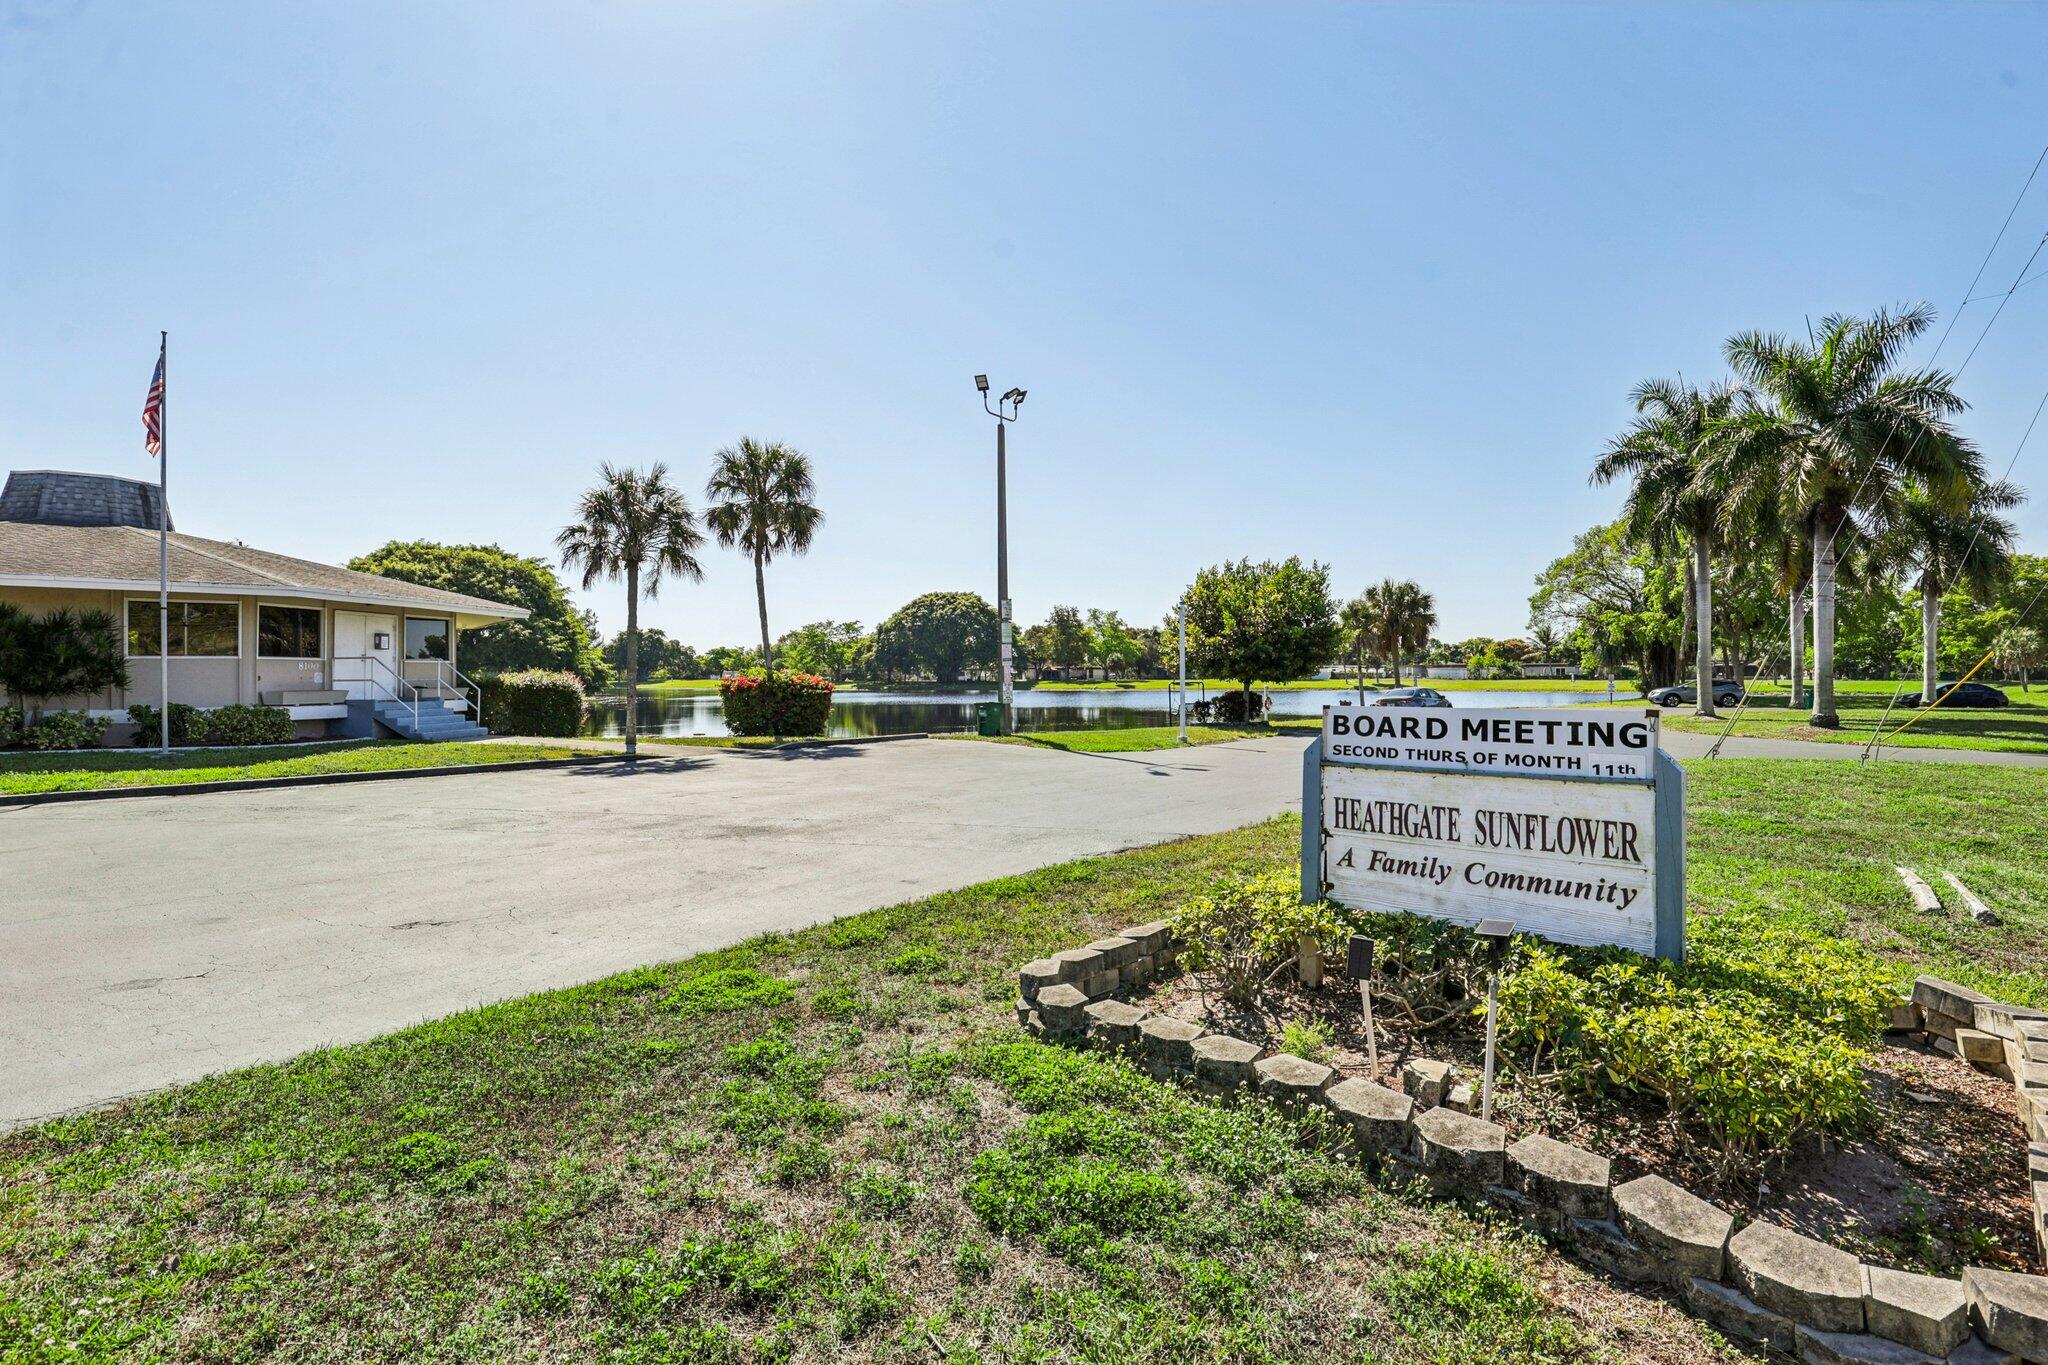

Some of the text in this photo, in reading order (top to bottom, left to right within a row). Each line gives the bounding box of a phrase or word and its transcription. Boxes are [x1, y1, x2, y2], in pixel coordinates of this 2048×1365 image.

[298, 662, 319, 670] 8100
[1332, 714, 1648, 748] BOARD MEETING
[1332, 744, 1636, 777] SECOND THURS OF MONTH 11th
[1333, 796, 1642, 864] HEATHGATE SUNFLOWER
[1336, 846, 1638, 911] A Family Community
